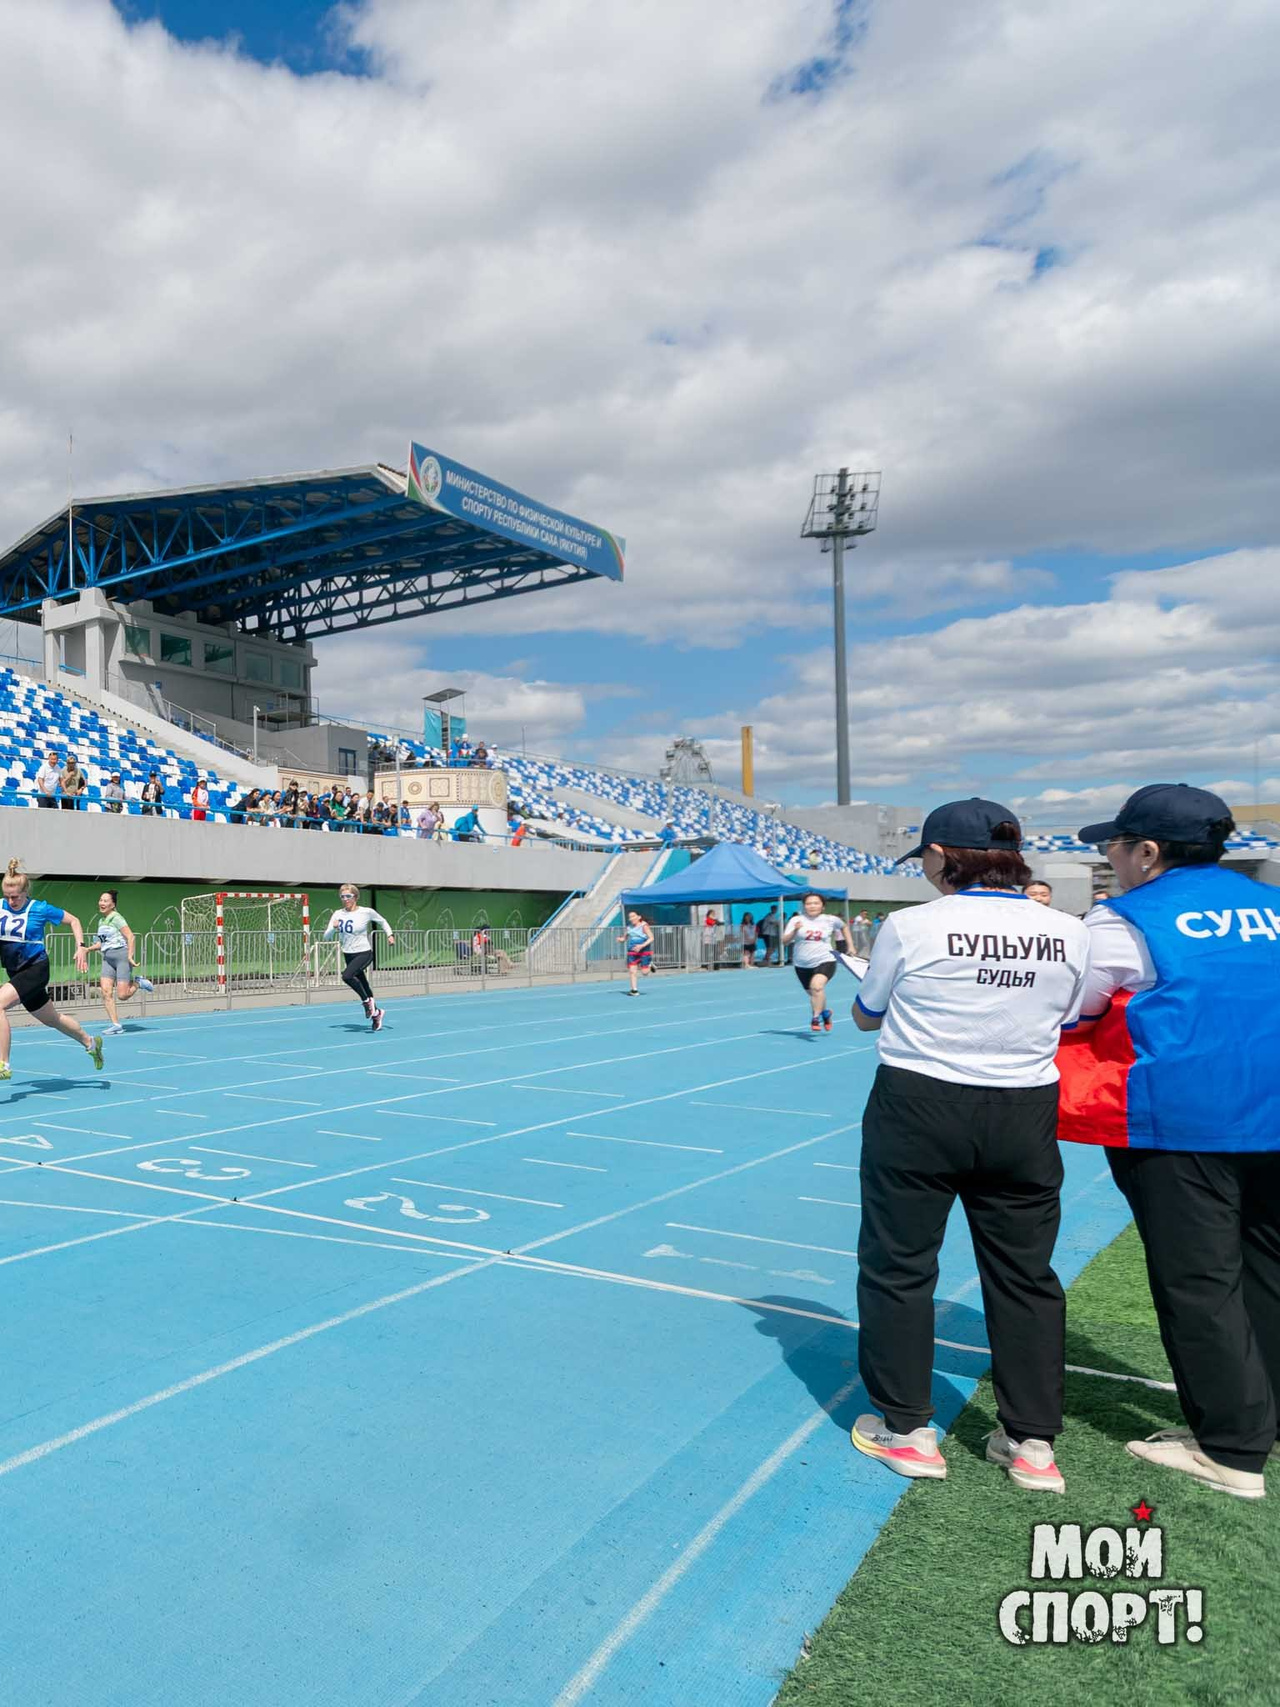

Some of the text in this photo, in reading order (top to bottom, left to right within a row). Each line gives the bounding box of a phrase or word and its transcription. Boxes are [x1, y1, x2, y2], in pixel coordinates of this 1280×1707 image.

[446, 470, 602, 549] МИНИСТЕРСТВО ПО ФИЗИЧЕСКОЙ КУЛЬТУРЕ И
[462, 496, 588, 560] СПОРТУ РЕСПУБЛИКИ САХА (ЯКУТИЯ)
[976, 968, 1036, 989] СУДЬЯ
[136, 1157, 252, 1181] 3
[344, 1191, 491, 1225] 2
